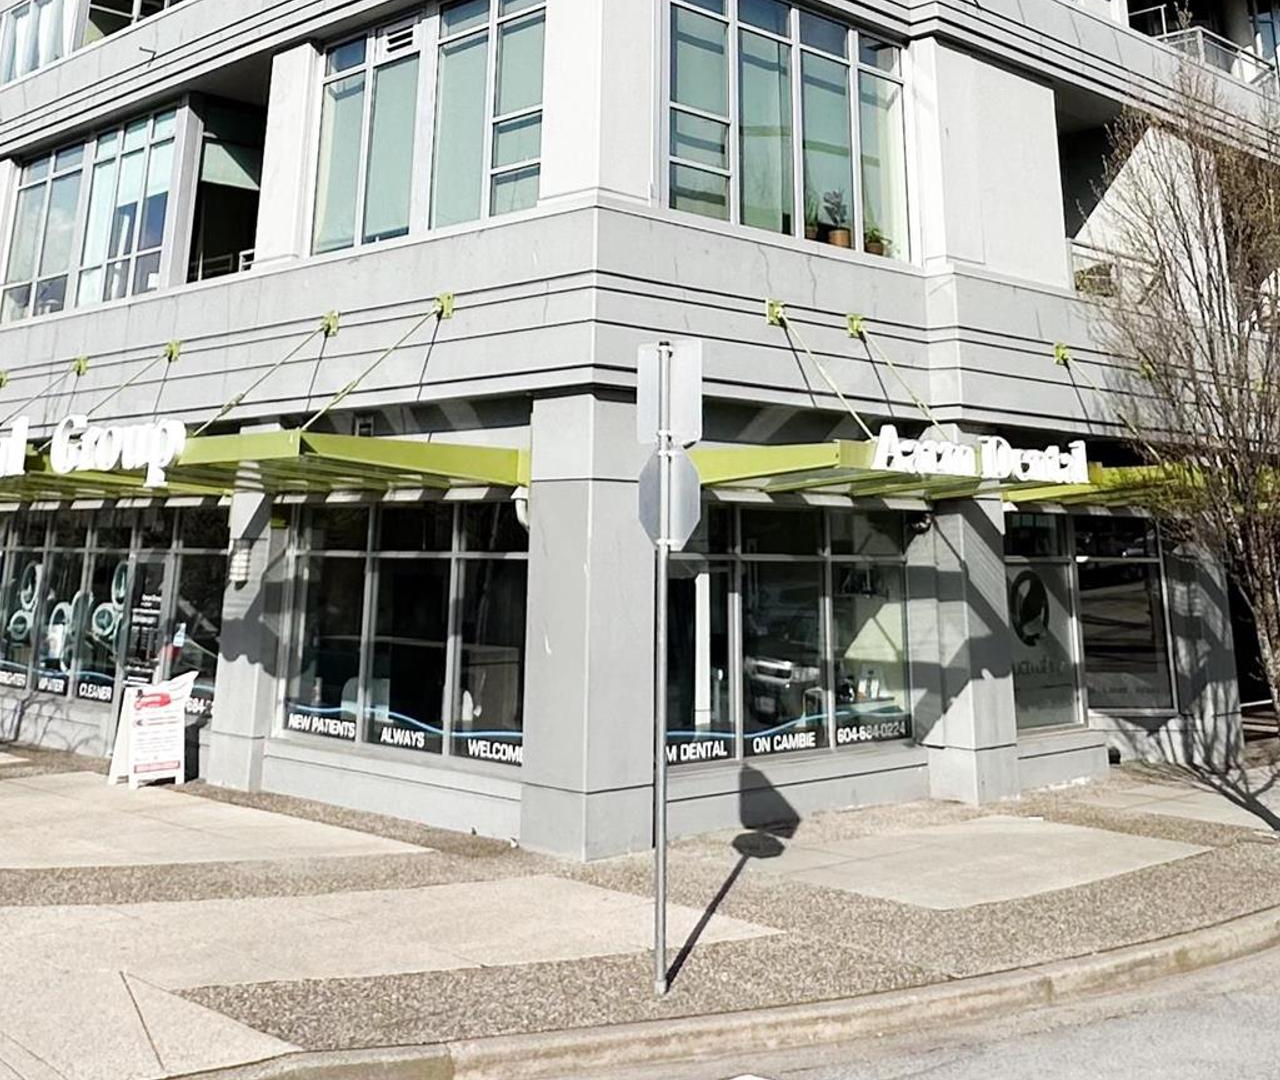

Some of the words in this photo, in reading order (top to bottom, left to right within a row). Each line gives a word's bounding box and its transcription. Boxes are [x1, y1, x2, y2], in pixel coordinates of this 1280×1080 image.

[50, 414, 187, 487] Group
[977, 436, 1088, 484] Dental
[79, 683, 113, 701] CLEANER
[288, 713, 311, 731] NEW
[311, 717, 356, 739] PATIENTS
[380, 727, 425, 749] ALWAYS
[837, 720, 907, 744] 604-684-0224
[680, 740, 728, 762] DENTAL
[753, 736, 770, 754] ON
[773, 730, 817, 751] CAMBIE
